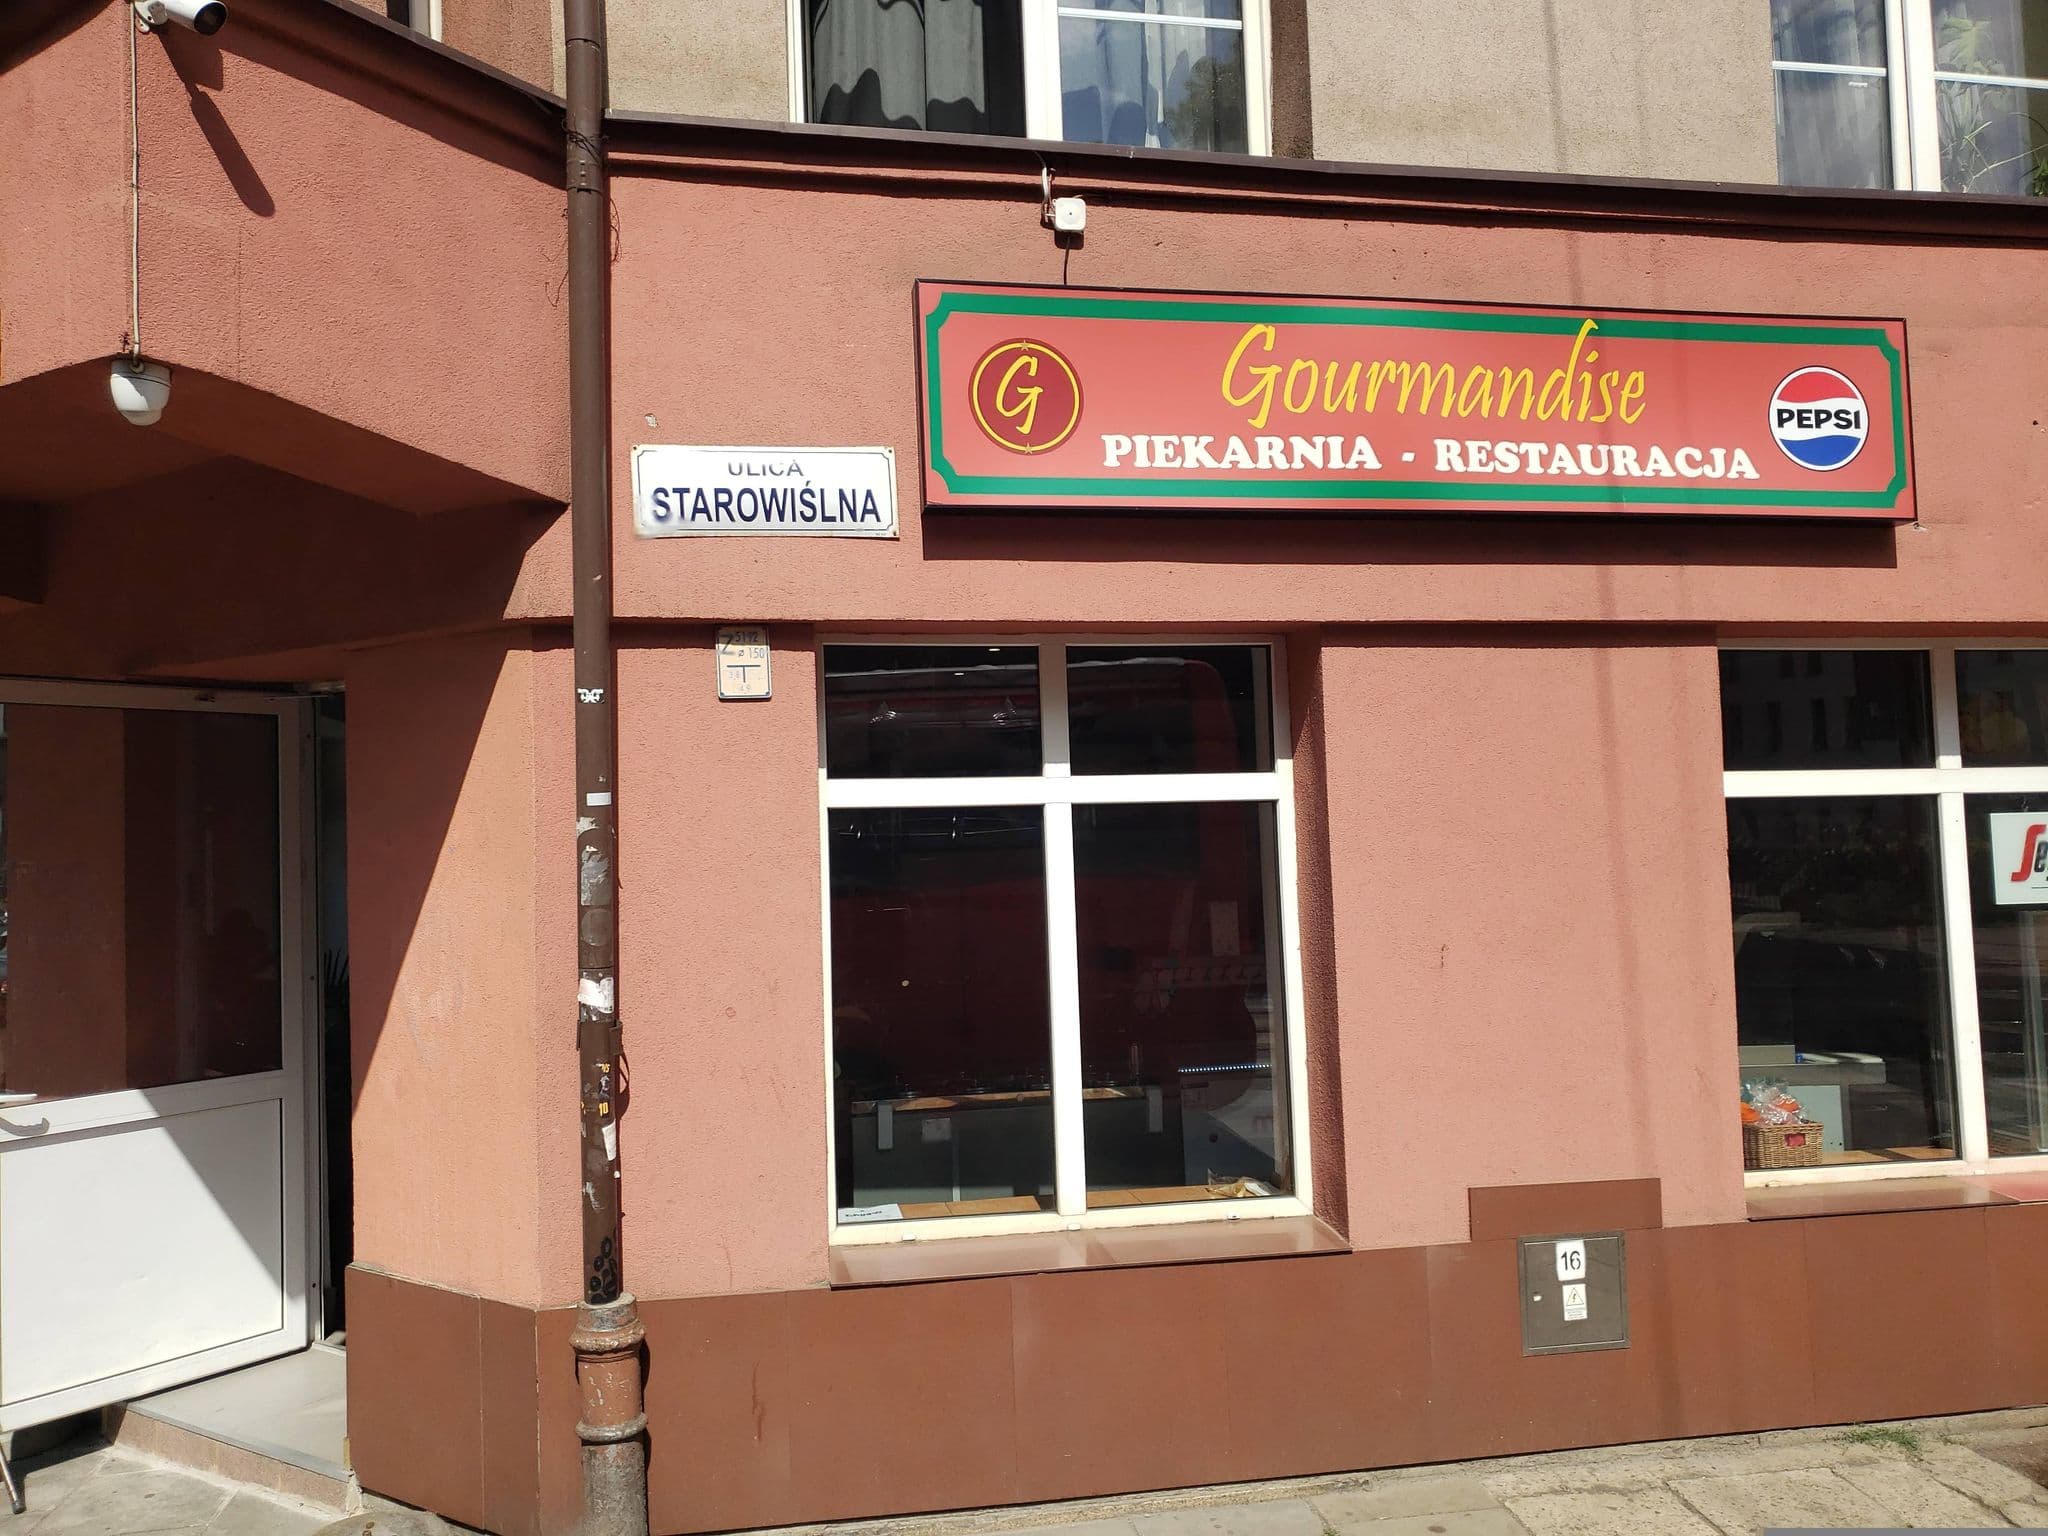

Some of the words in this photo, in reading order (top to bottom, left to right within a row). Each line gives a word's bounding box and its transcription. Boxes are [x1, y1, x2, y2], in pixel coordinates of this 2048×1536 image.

[995, 355, 1044, 434] G
[1220, 318, 1647, 429] Gourmandise
[1776, 408, 1861, 431] PEPSI
[728, 459, 804, 477] ULICA
[1101, 434, 1382, 470] PIEKARNIA
[1433, 438, 1760, 480] RESTAURACJA
[652, 480, 881, 524] STAROWIŚLNA
[2011, 824, 2048, 883] Se
[1560, 1250, 1582, 1271] 16
